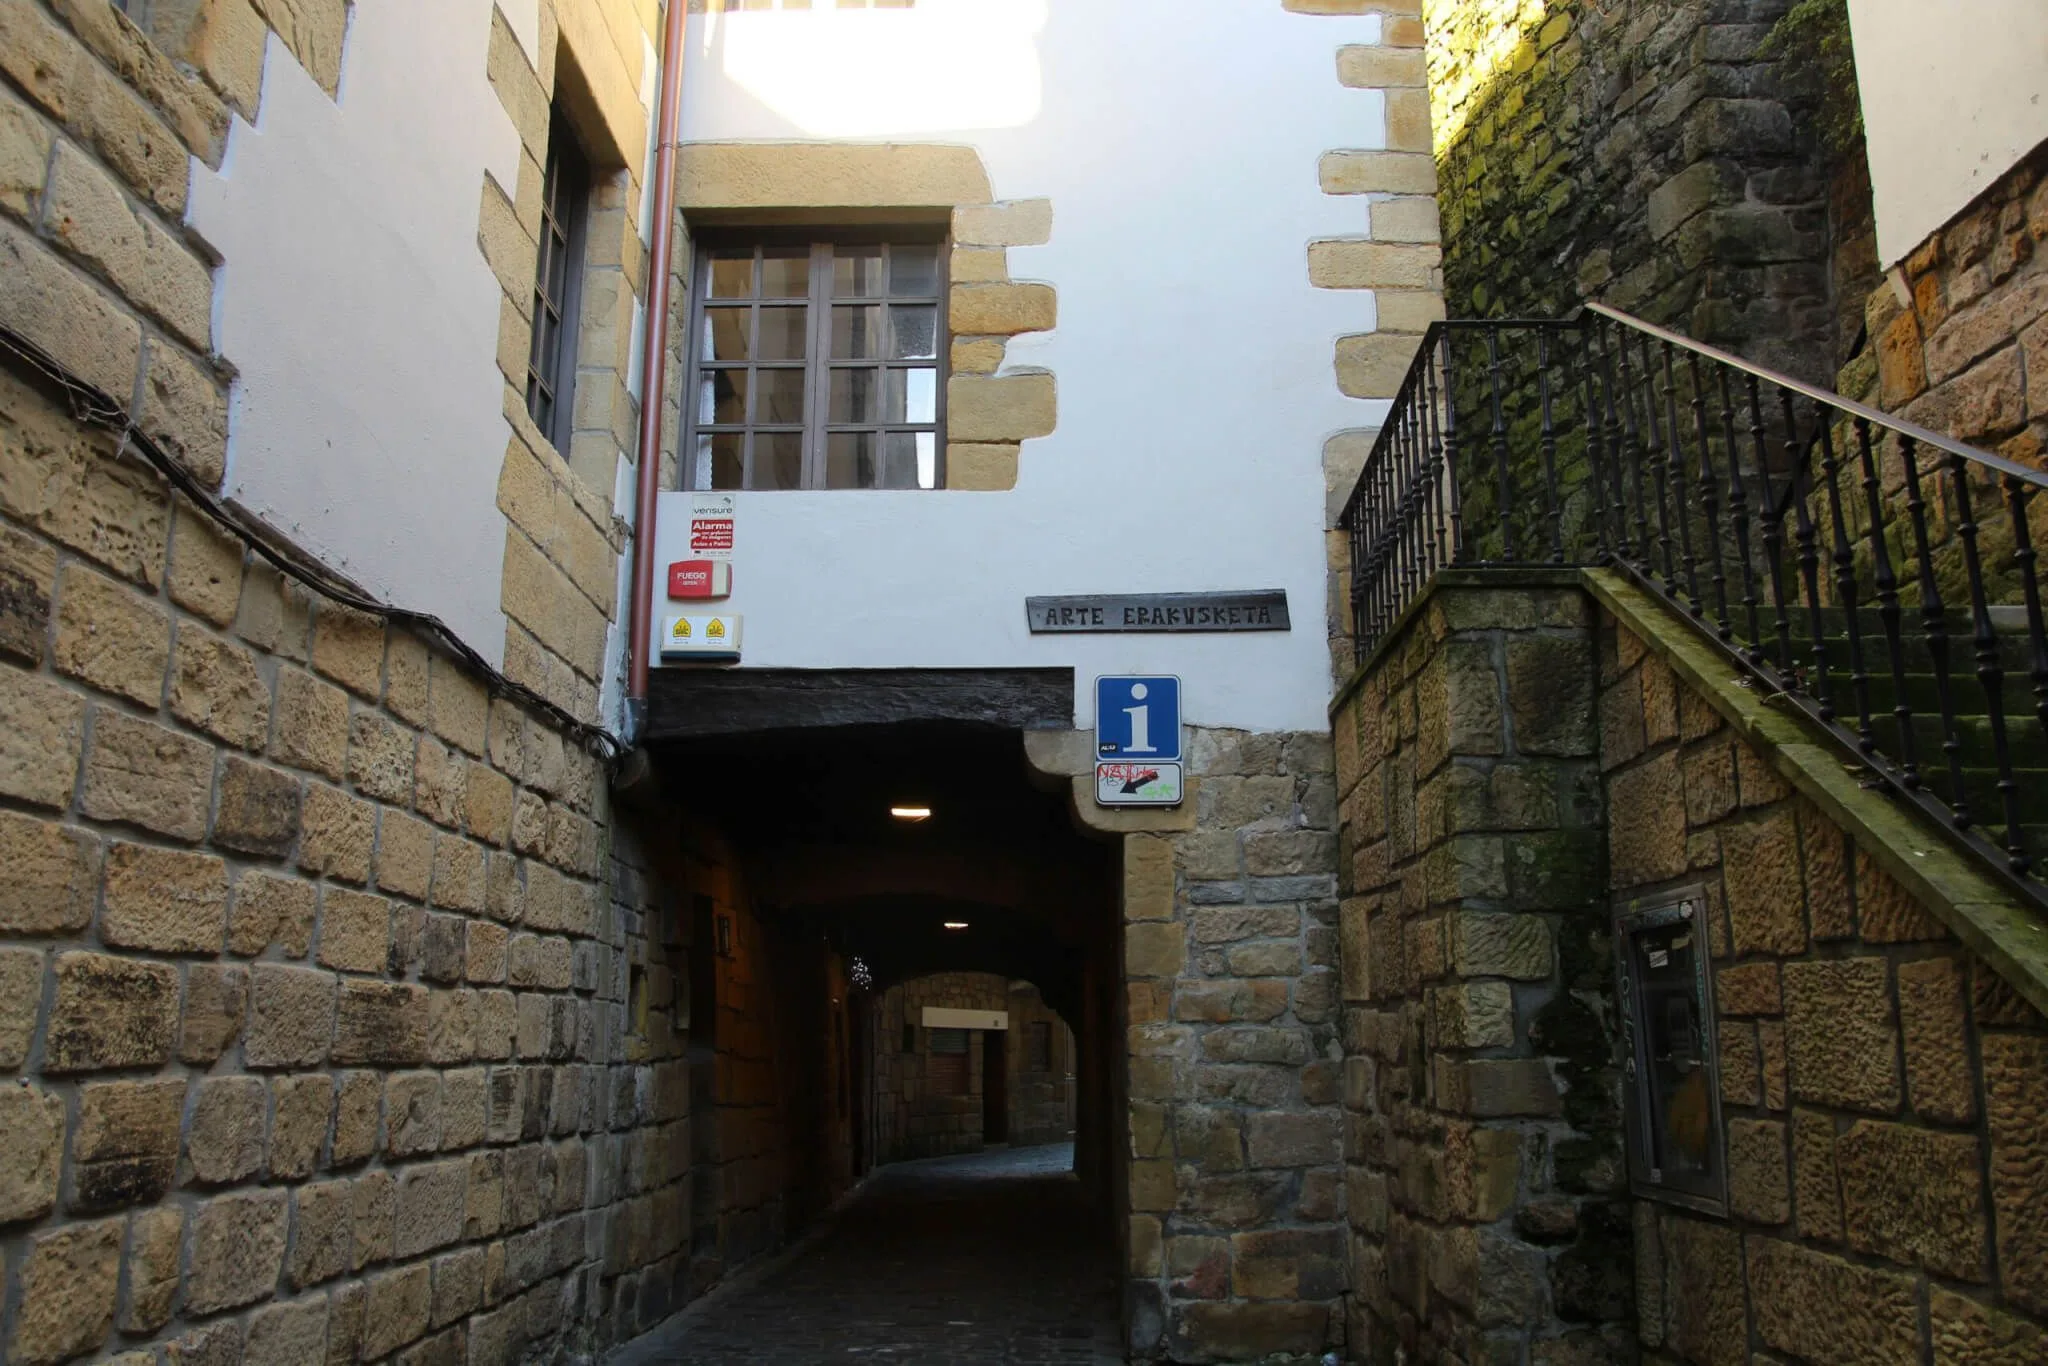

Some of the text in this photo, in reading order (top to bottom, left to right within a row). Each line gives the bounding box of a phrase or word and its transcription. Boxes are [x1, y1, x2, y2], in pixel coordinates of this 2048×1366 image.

[693, 521, 732, 530] Alarma
[677, 571, 707, 580] FUEGO
[1045, 607, 1104, 626] ARTE
